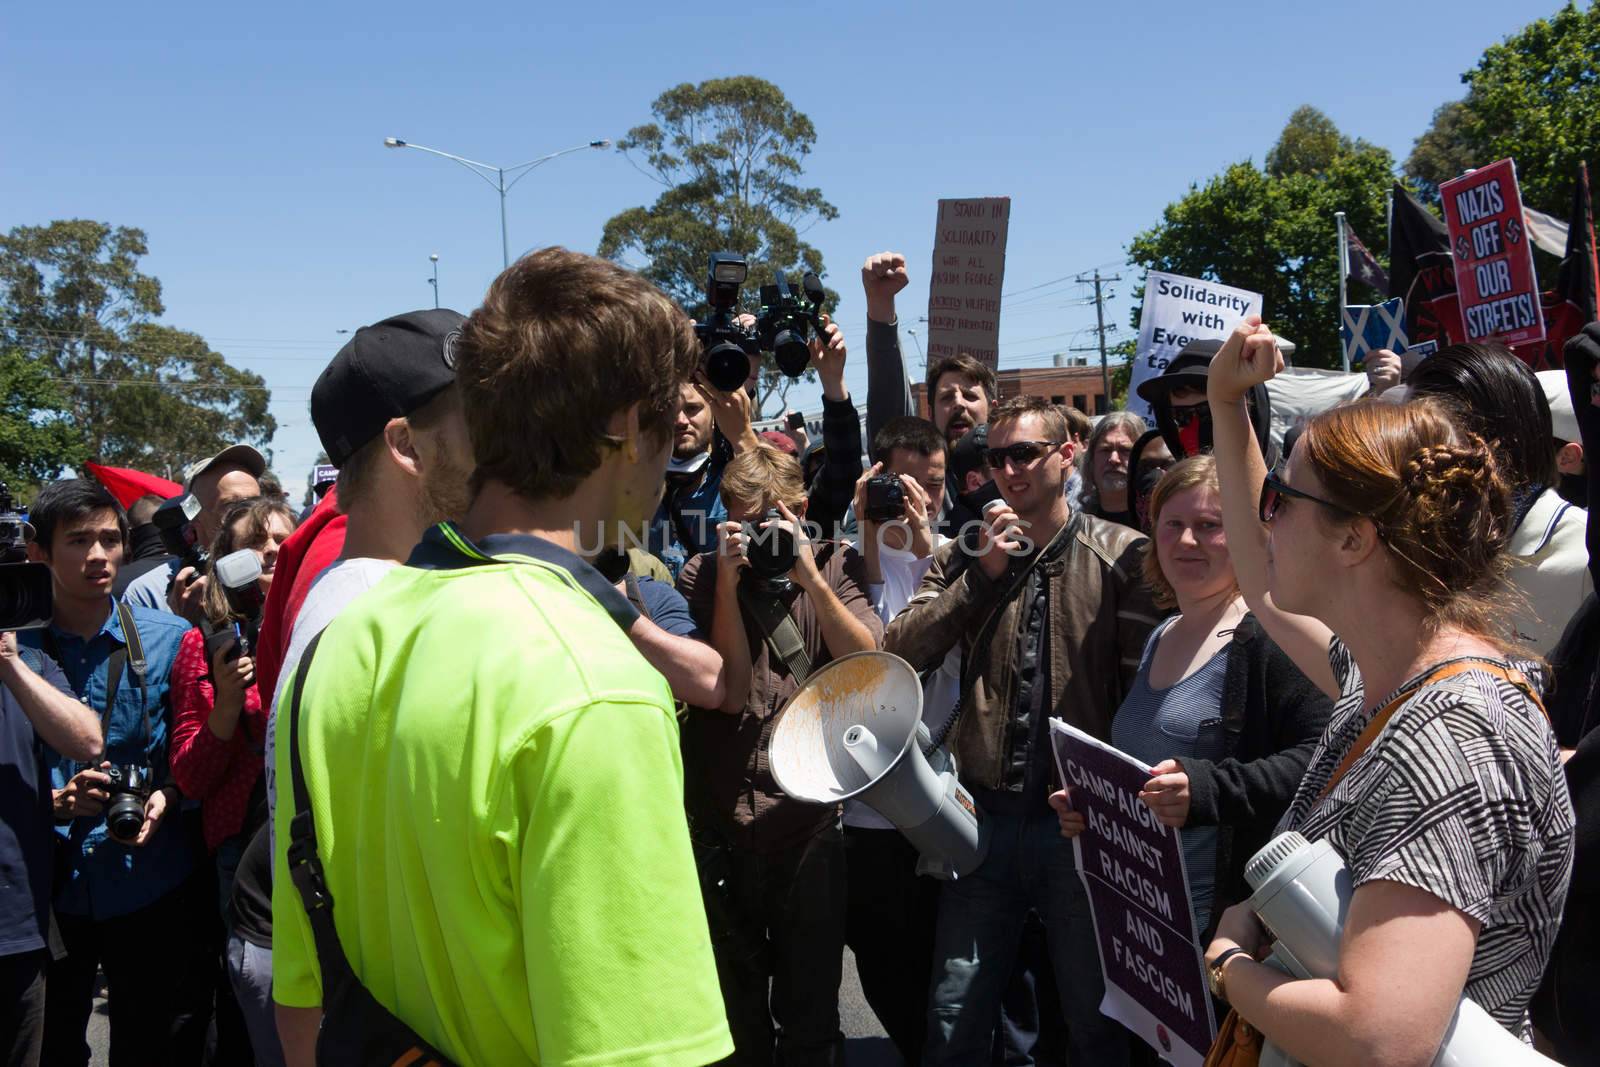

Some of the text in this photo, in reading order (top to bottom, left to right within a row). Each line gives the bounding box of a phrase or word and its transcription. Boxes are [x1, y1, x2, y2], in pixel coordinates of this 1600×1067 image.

[953, 201, 985, 217] STAND
[991, 203, 1003, 219] IN
[1456, 180, 1503, 225] NAZIS
[942, 229, 996, 246] SOLIDARITY
[1472, 221, 1499, 259] OFF
[1158, 279, 1251, 316] Solidarity
[1477, 260, 1511, 298] OUR
[1182, 311, 1225, 331] with
[1466, 293, 1536, 338] STREETS!
[1066, 759, 1167, 838] CAMPAIGN
[1088, 805, 1164, 877] AGAINST
[1099, 849, 1173, 921] RACISM
[1126, 909, 1164, 957] AND
[1112, 935, 1195, 1021] FASCISM
